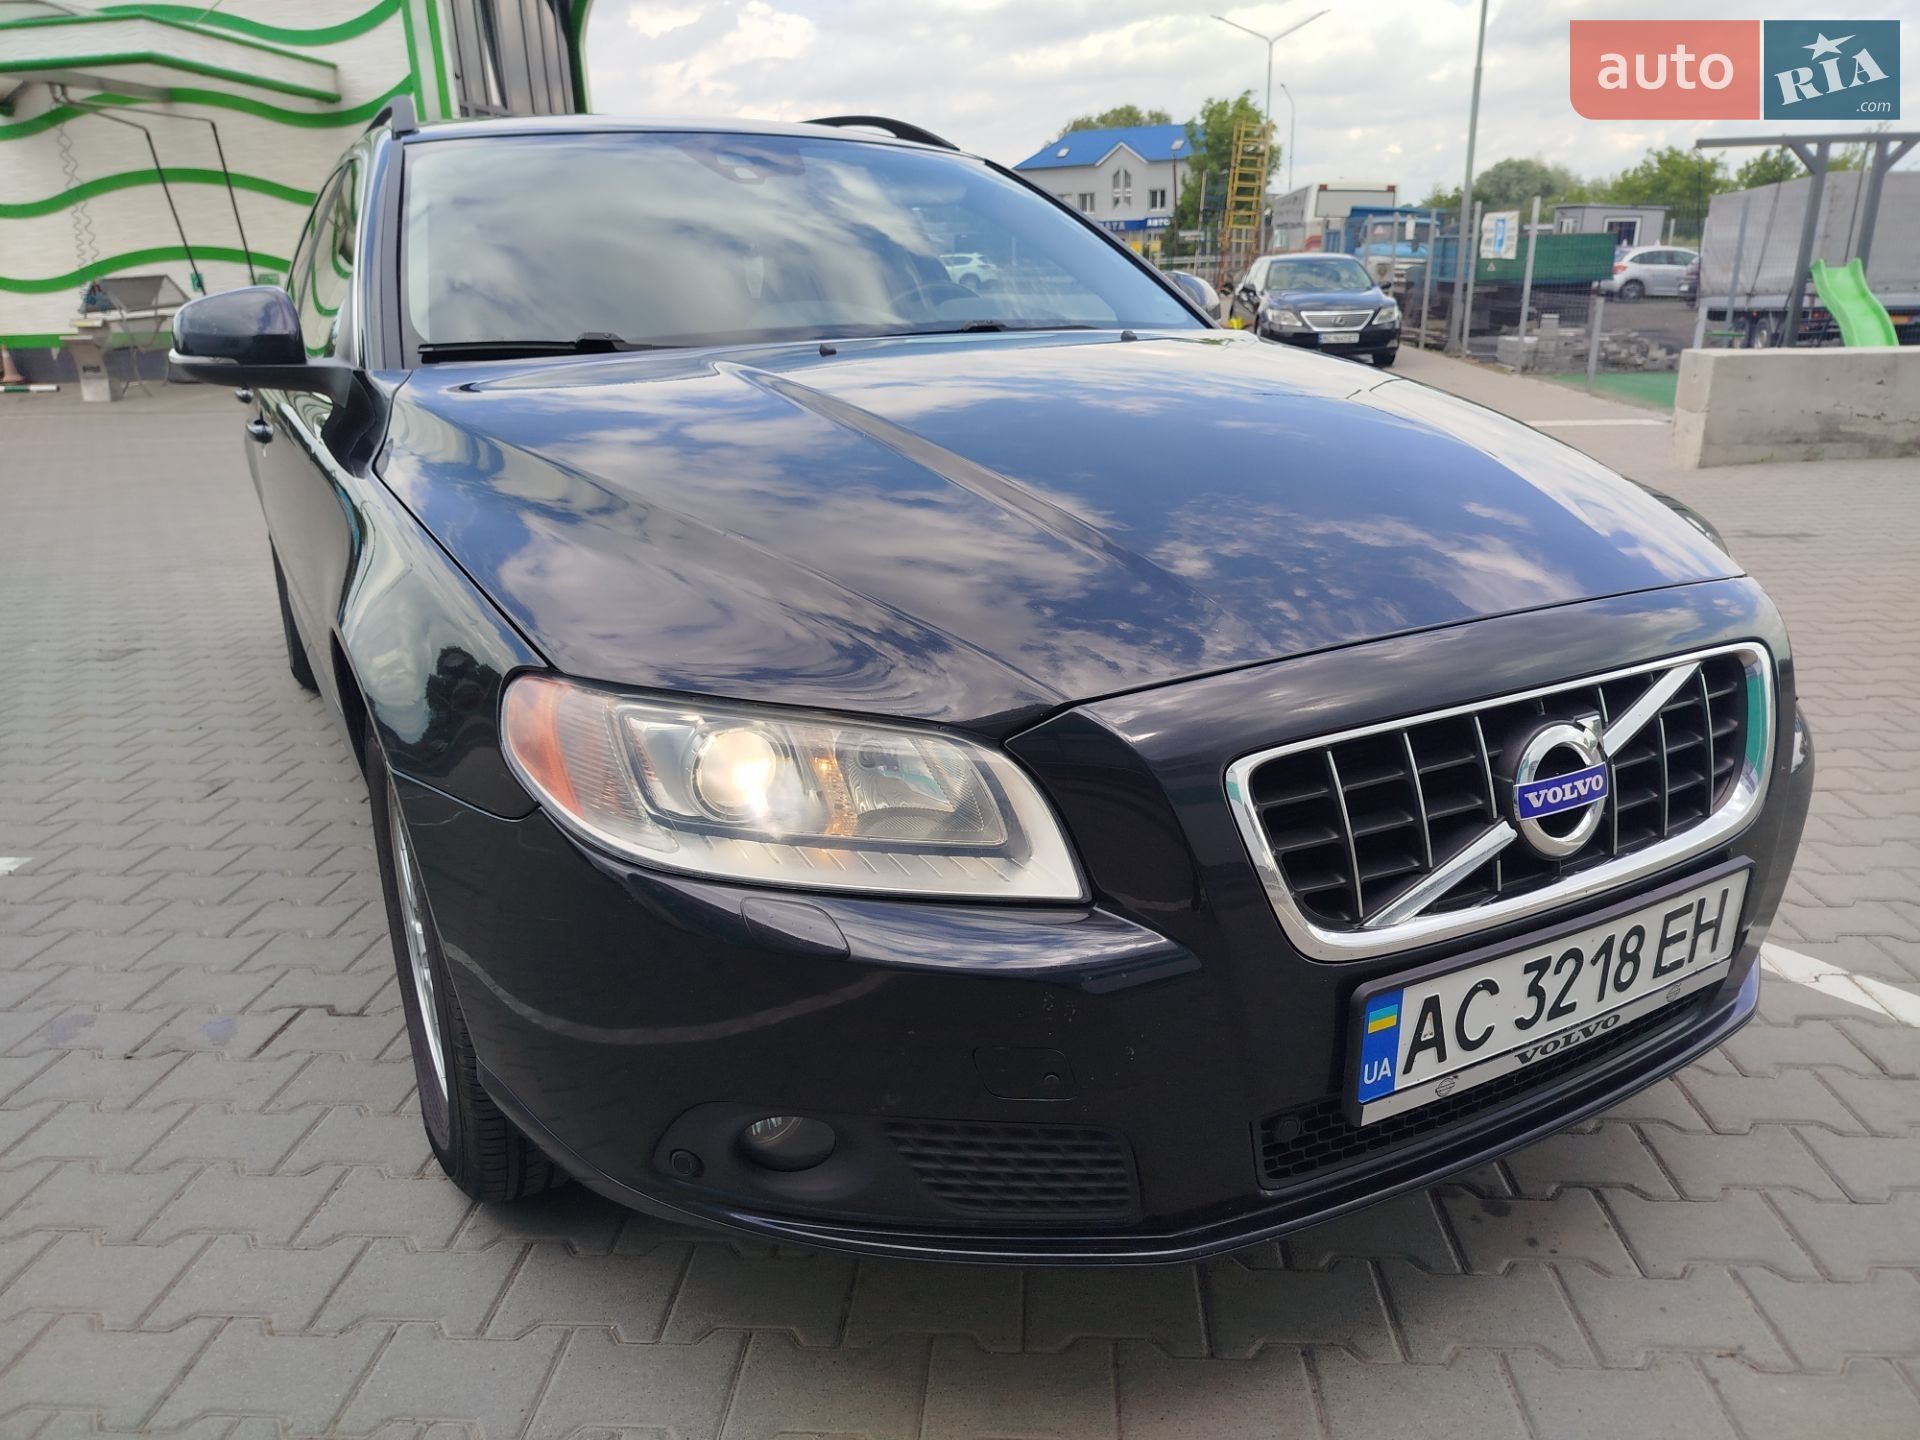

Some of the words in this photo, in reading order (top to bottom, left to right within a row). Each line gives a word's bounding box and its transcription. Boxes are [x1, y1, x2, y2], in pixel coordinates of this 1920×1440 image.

[1524, 774, 1604, 808] VOLVO
[1402, 978, 1500, 1075] AC
[1514, 925, 1646, 1031] 3218
[1653, 887, 1729, 979] EH
[1514, 1014, 1620, 1064] VOLVO
[1363, 1057, 1392, 1085] UA
